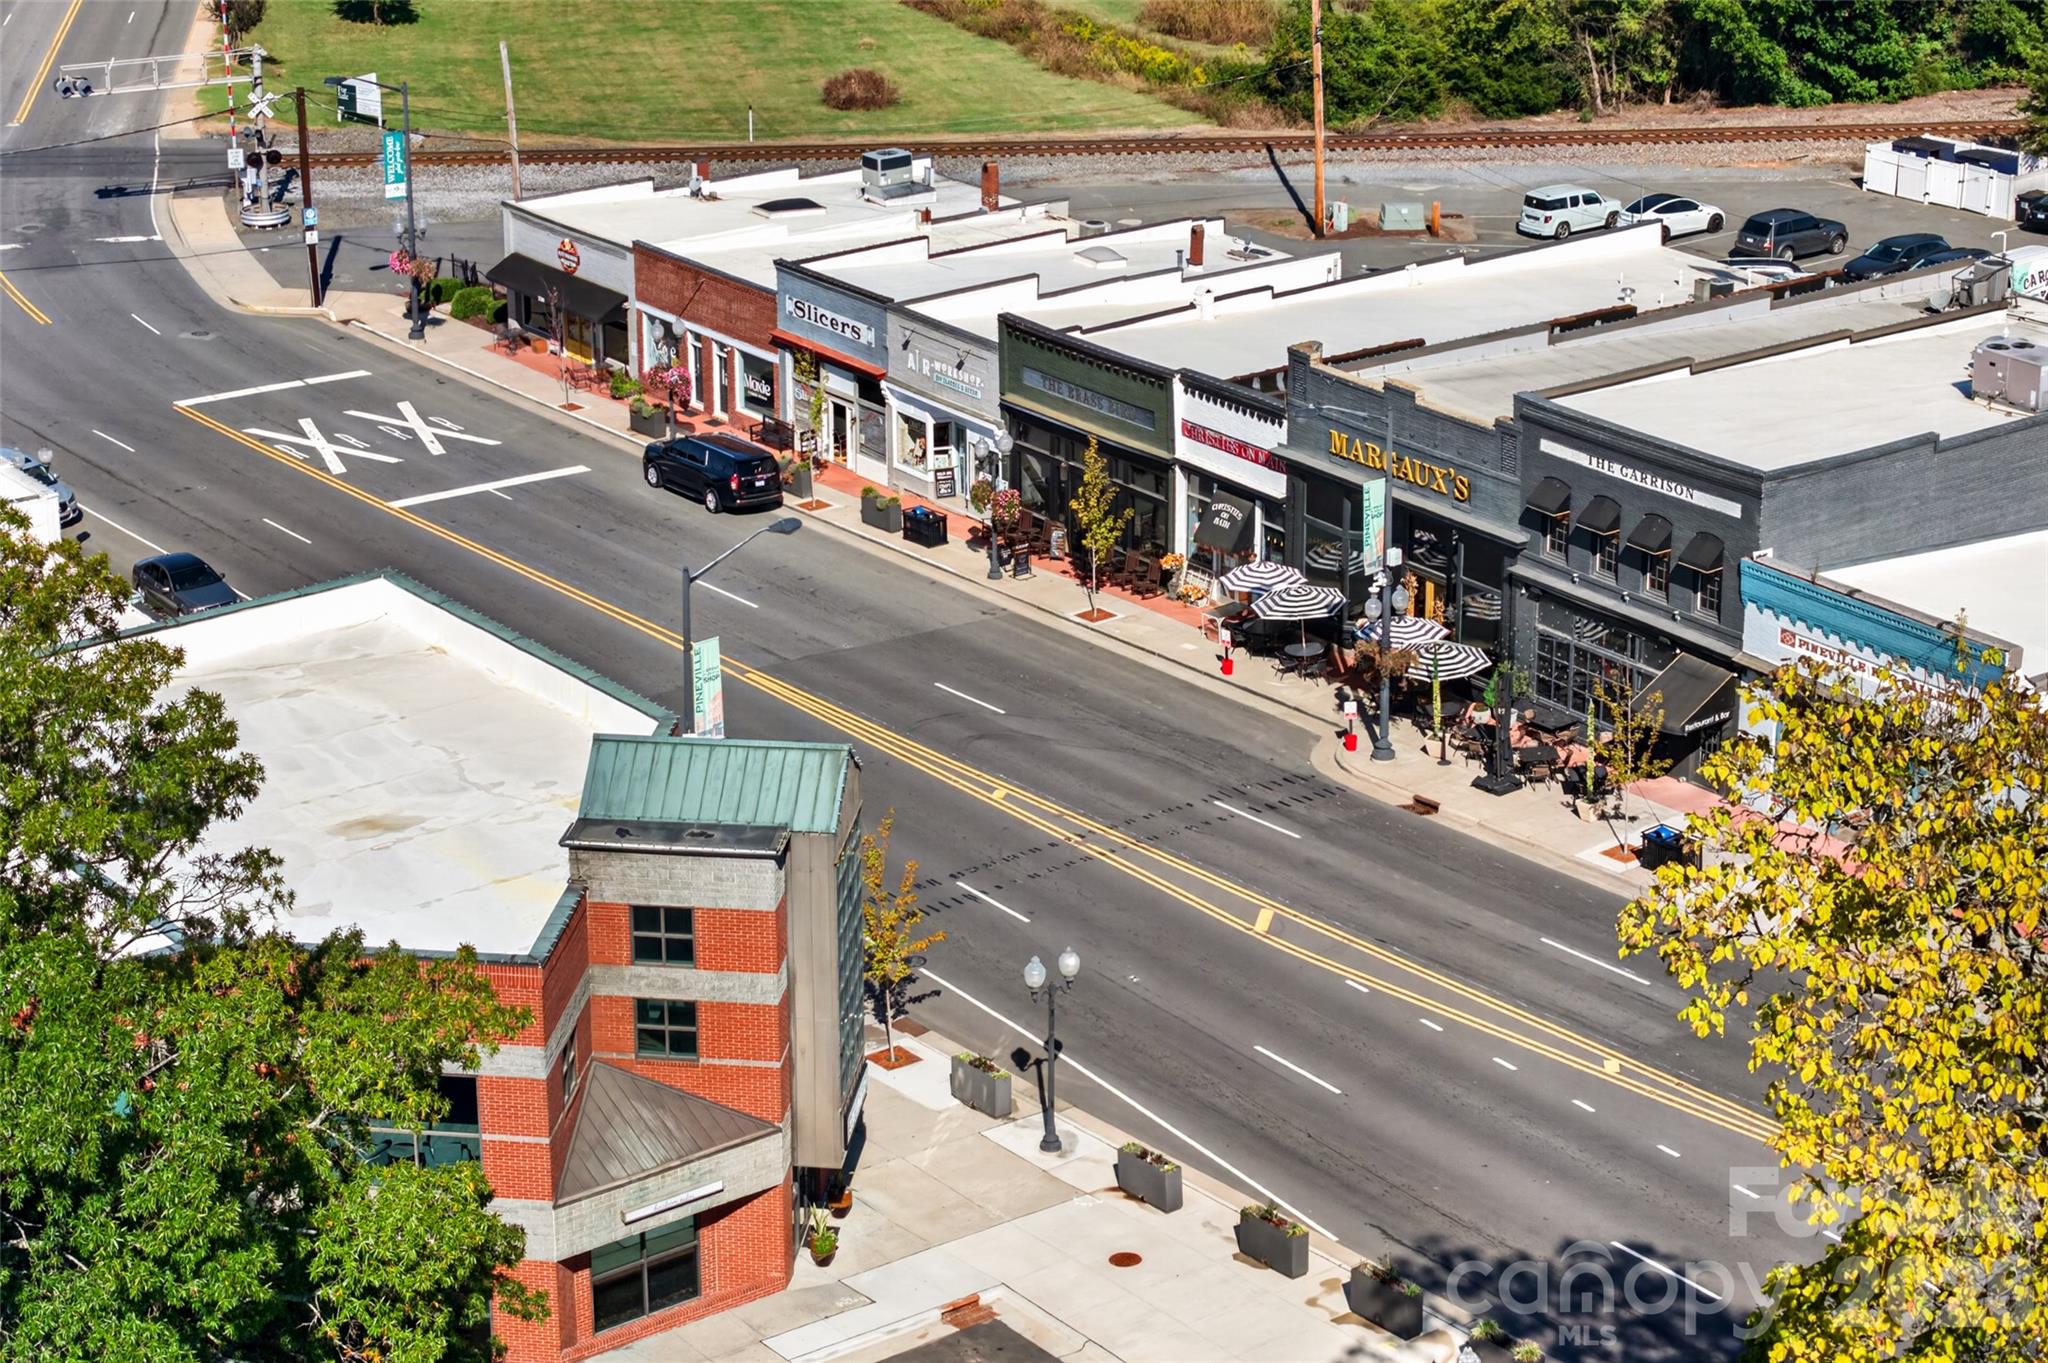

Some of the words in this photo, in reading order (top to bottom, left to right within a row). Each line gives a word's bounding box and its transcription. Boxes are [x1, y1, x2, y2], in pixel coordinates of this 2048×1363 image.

[386, 136, 395, 183] WELCOME
[793, 300, 861, 340] Slicers
[1040, 374, 1063, 396] THE
[1068, 384, 1104, 410] BRASS
[1184, 424, 1239, 455] CHRISTIES
[1241, 447, 1256, 461] ON
[1258, 450, 1287, 473] MAIN
[1329, 429, 1471, 501] MARGAUX'S
[1587, 454, 1615, 474] THE
[1620, 464, 1695, 501] GARRISON
[1798, 637, 1866, 673] PINEVILLE
[694, 647, 704, 714] PINEVILLE
